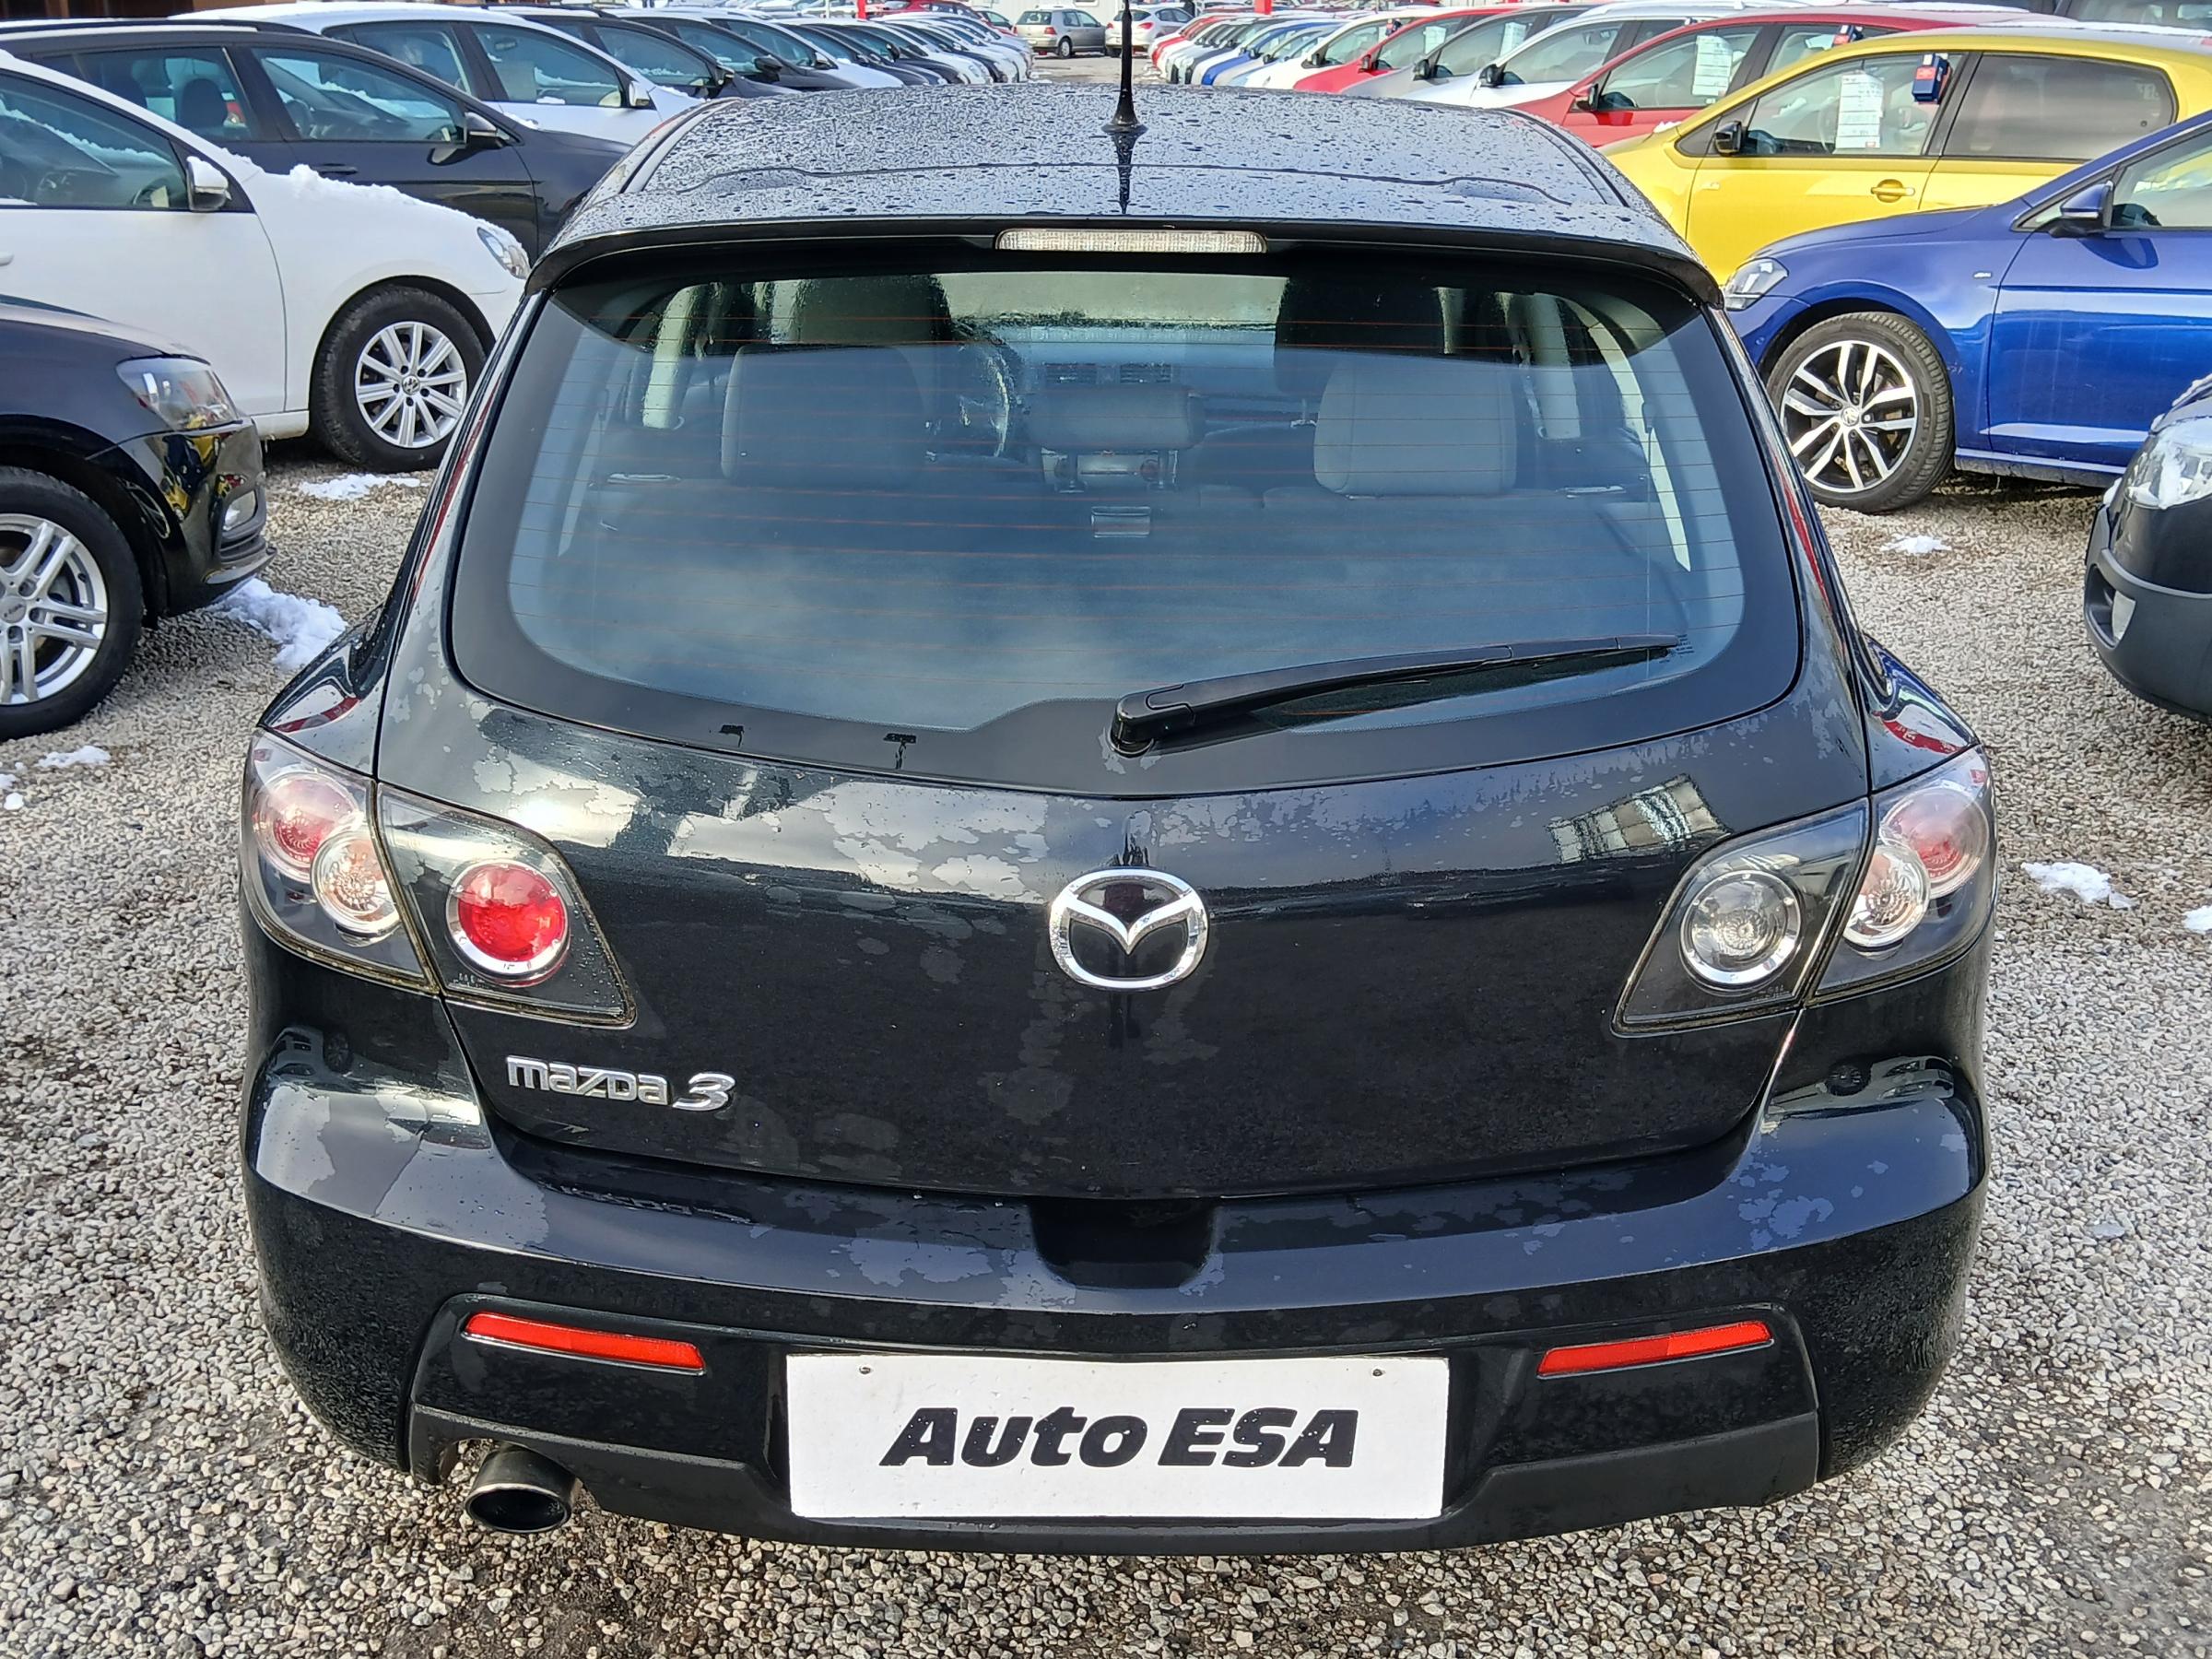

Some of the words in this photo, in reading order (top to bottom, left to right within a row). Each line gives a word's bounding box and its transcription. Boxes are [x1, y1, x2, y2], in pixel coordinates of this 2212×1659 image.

[673, 1073, 735, 1112] 3
[878, 1407, 1147, 1467] Auto
[1157, 1407, 1359, 1468] ESA
